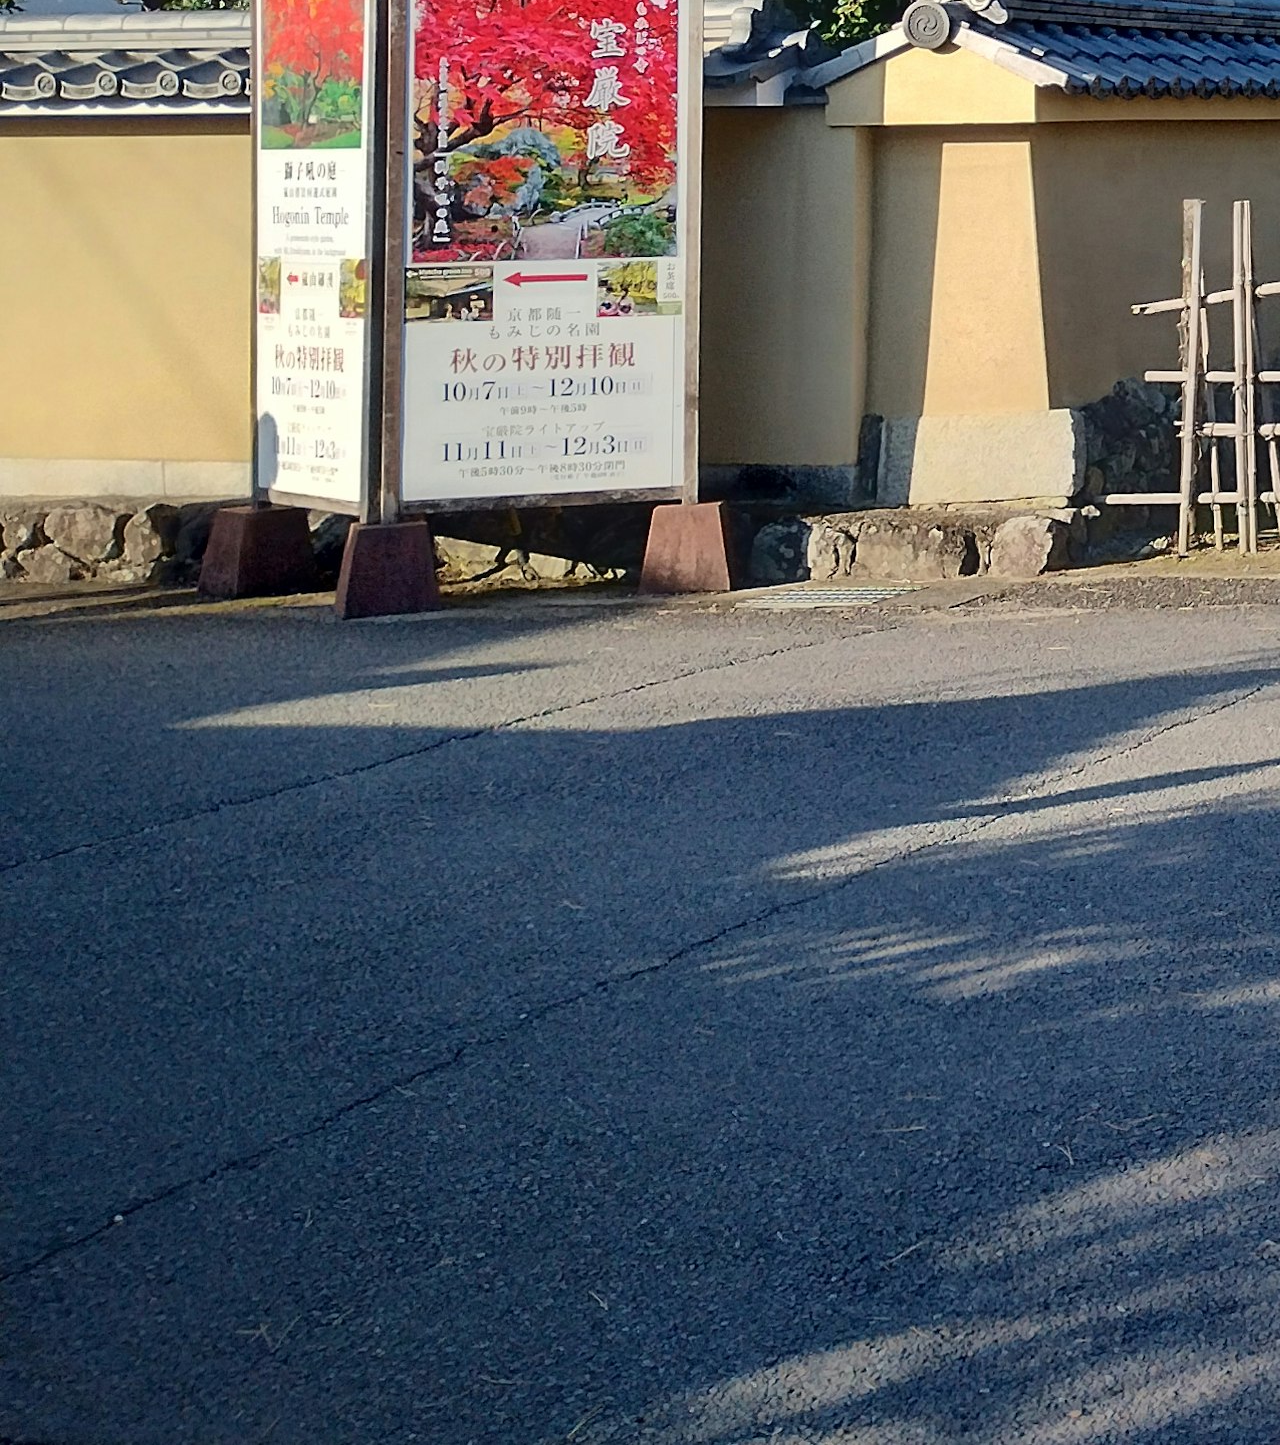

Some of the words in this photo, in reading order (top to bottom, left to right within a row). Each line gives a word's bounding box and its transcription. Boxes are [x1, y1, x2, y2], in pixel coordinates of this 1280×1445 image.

[583, 17, 632, 160] 宝厳院
[272, 205, 310, 228] Hogonin
[314, 205, 350, 229] Temple
[506, 306, 582, 323] 京都随一
[489, 322, 601, 340] もみじの名園
[275, 343, 344, 373] 秋の特別拝観
[450, 341, 636, 374] 秋の特別拝観
